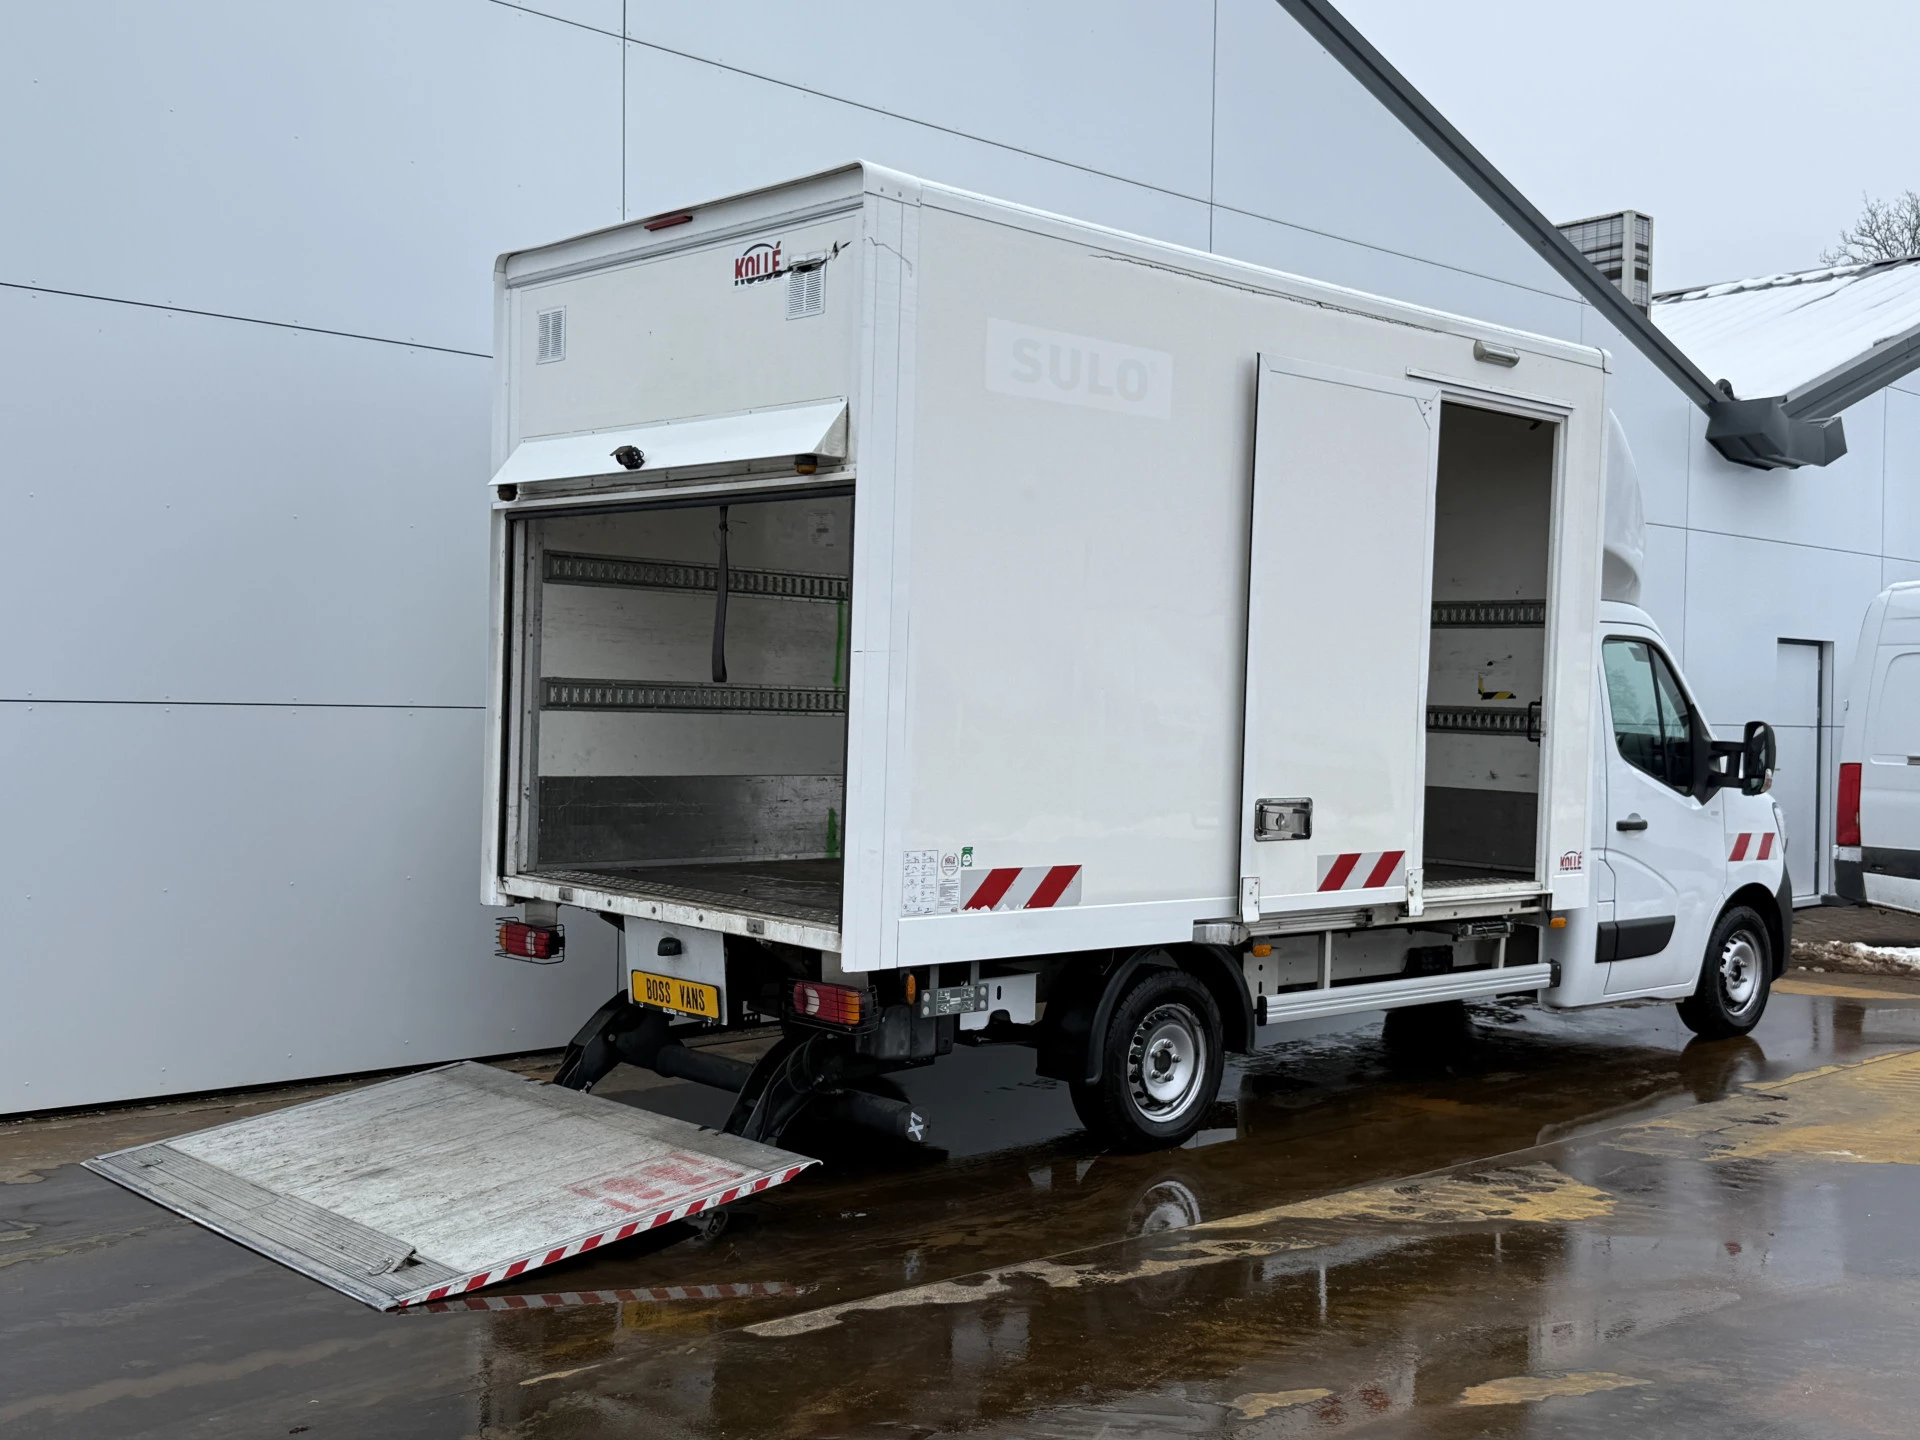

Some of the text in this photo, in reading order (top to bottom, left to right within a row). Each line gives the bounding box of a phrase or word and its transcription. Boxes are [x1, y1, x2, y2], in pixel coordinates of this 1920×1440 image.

[1011, 338, 1148, 402] SULO
[646, 978, 705, 1011] BOSS VANS
